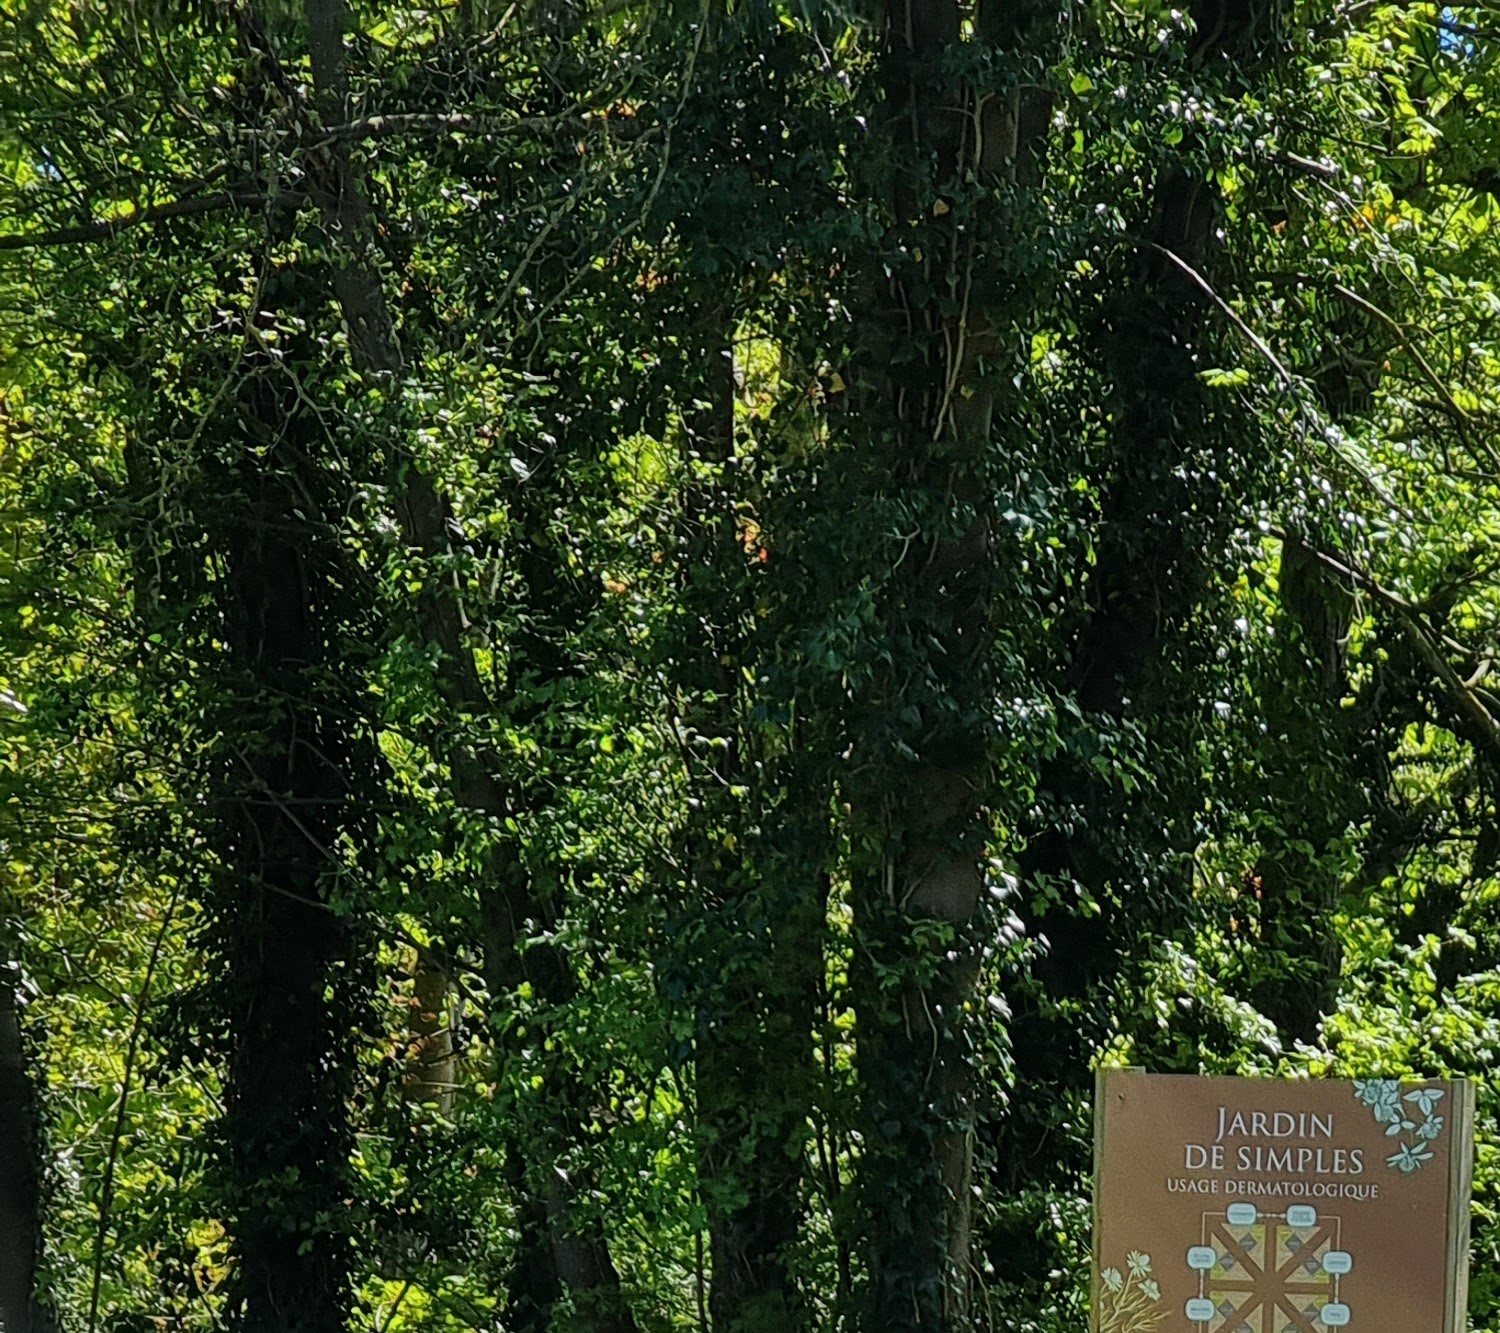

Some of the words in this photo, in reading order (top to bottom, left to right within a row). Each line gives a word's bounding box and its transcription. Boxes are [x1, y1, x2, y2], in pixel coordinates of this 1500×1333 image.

[1215, 1107, 1334, 1142] JARDIN
[1184, 1144, 1225, 1170] DE
[1236, 1146, 1364, 1175] SIMPLES
[1167, 1178, 1218, 1194] USAGE
[1225, 1179, 1379, 1200] DERMATOLOGIQUE
